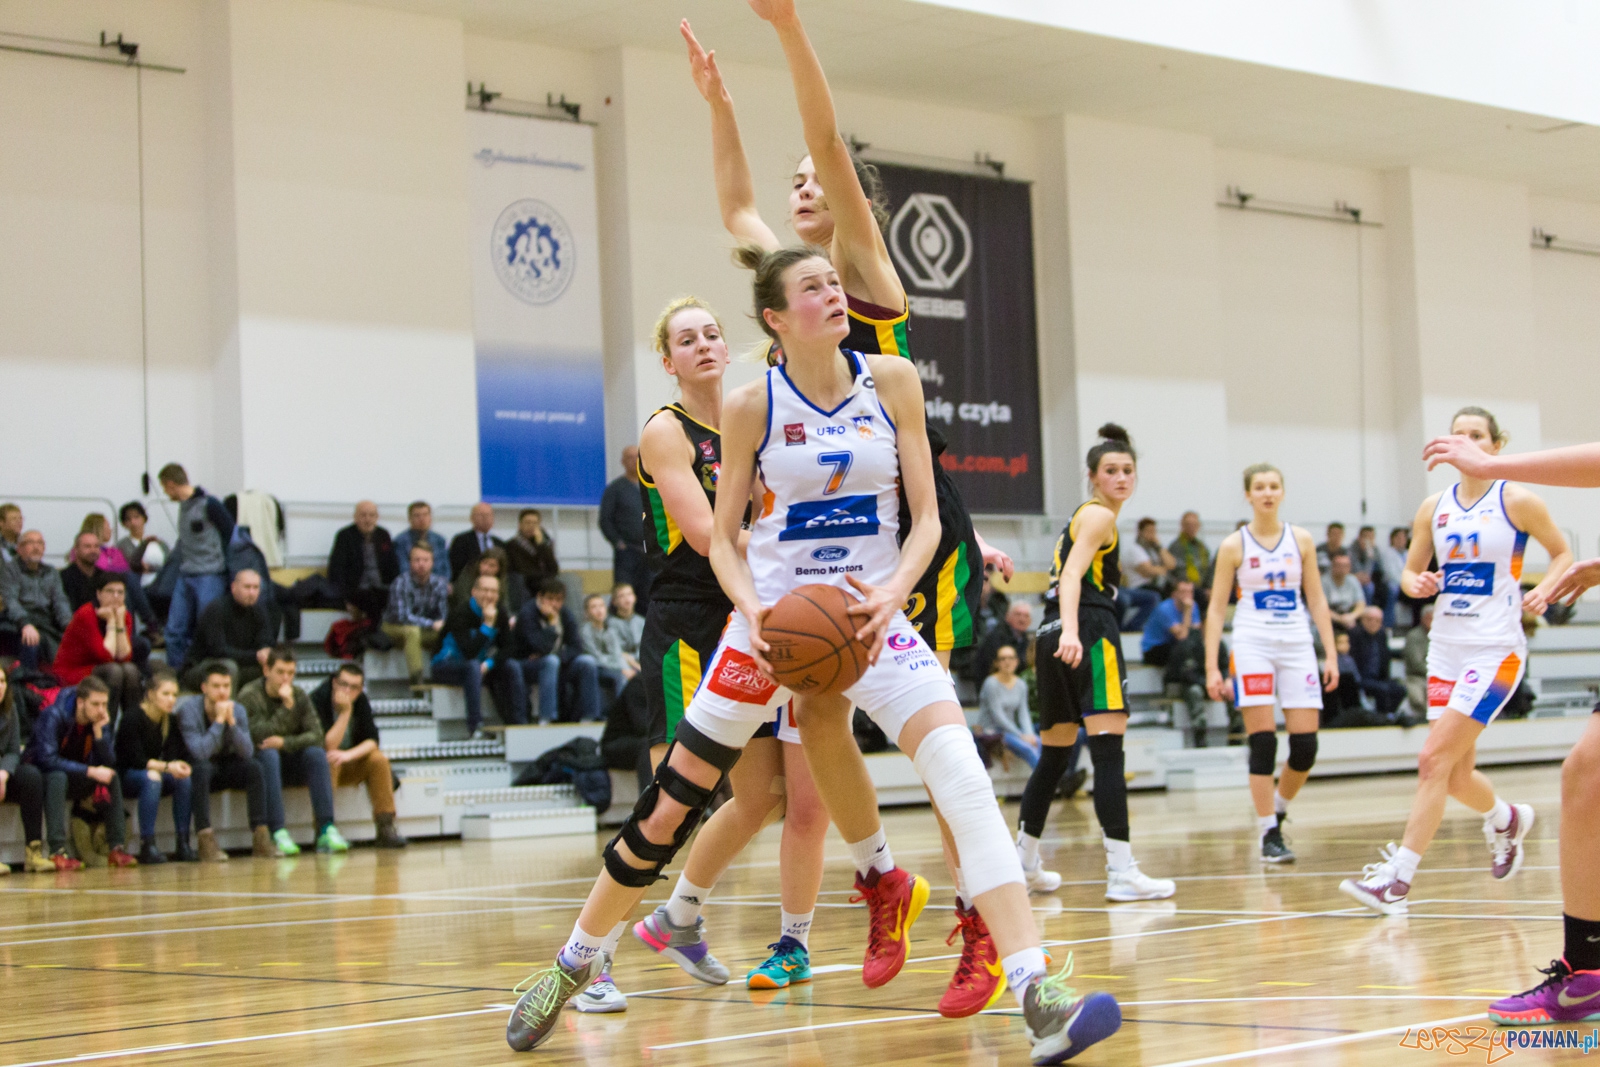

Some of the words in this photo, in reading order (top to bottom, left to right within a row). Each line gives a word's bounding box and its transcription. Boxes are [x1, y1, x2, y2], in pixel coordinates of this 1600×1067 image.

[958, 401, 1012, 427] czyta
[817, 450, 854, 496] 7
[818, 547, 844, 559] Ford
[1445, 531, 1481, 559] 21
[795, 567, 827, 576] Bemo
[828, 564, 864, 575] Motors
[1263, 571, 1287, 591] 11
